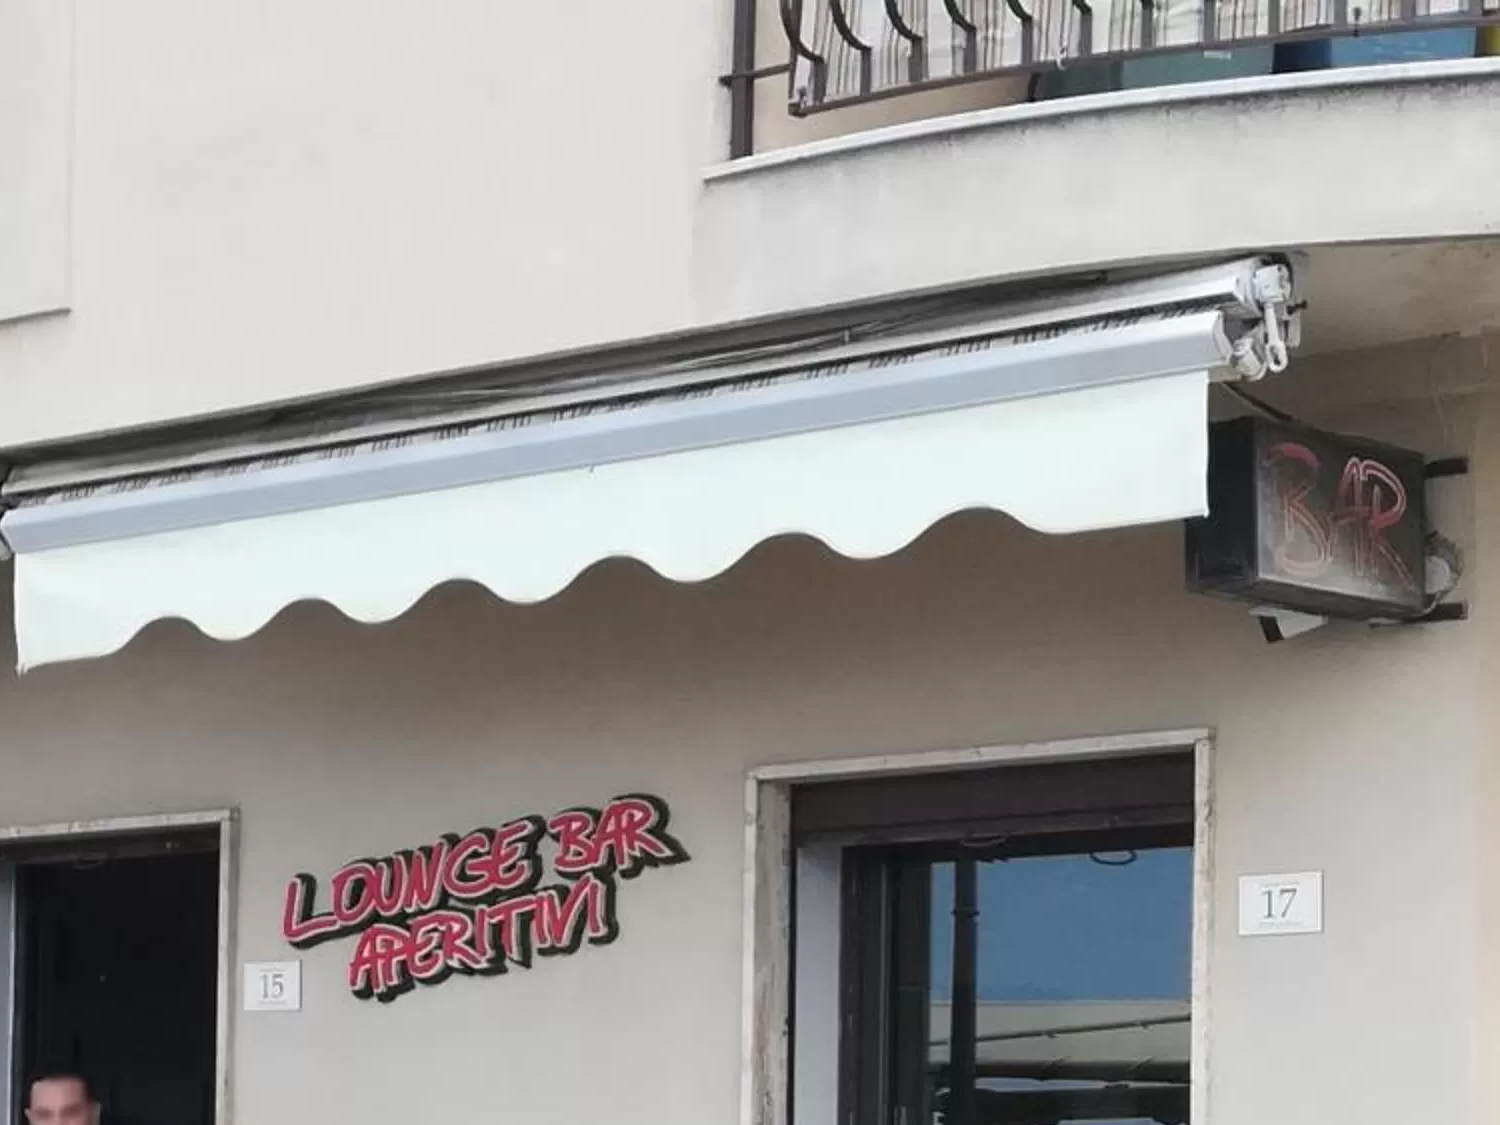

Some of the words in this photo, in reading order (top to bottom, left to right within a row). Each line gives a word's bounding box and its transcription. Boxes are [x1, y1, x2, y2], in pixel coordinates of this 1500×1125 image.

[1263, 441, 1416, 592] BAR
[281, 817, 542, 945] LOUNGE
[548, 796, 682, 875] BAR
[1261, 887, 1297, 918] 17
[260, 973, 284, 999] 15
[347, 874, 616, 1000] APERITIVI
